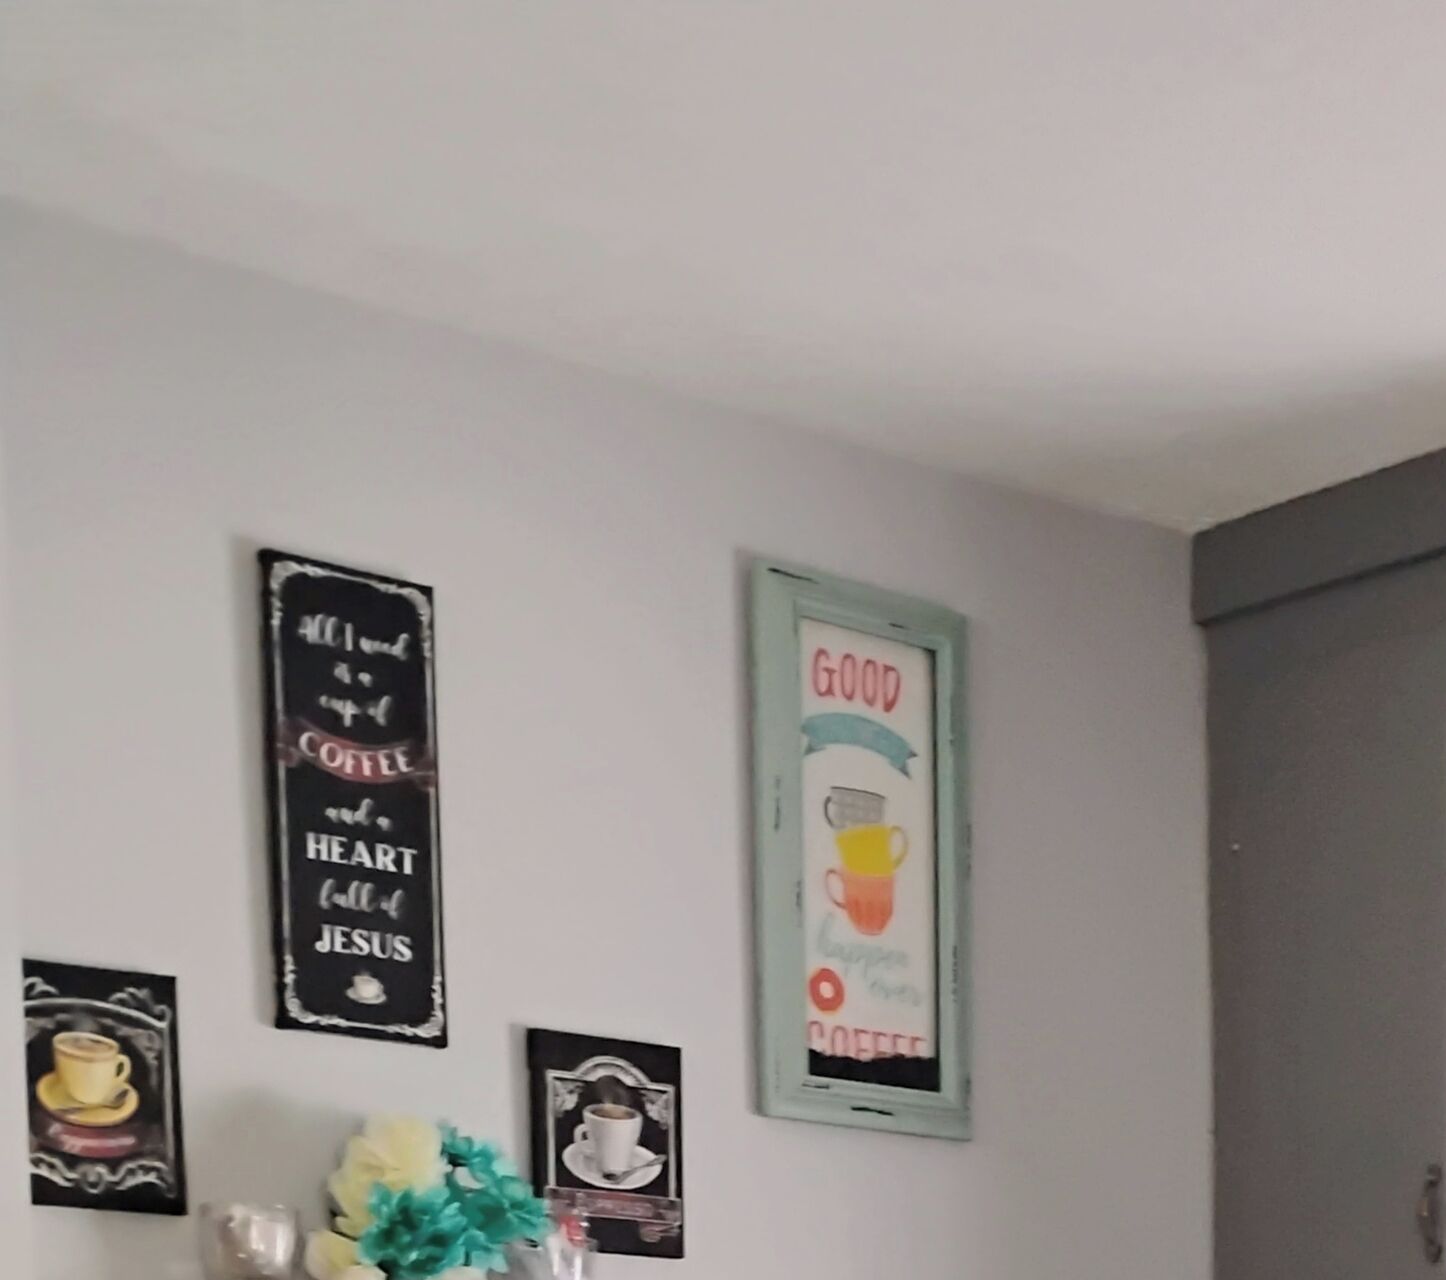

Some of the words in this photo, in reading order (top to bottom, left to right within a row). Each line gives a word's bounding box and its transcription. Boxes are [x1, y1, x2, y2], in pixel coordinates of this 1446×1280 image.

[298, 613, 340, 648] All
[343, 621, 354, 652] I
[812, 646, 903, 713] GOOD
[298, 730, 416, 778] COFFEE
[305, 831, 419, 876] HEART
[313, 923, 413, 963] JESUS
